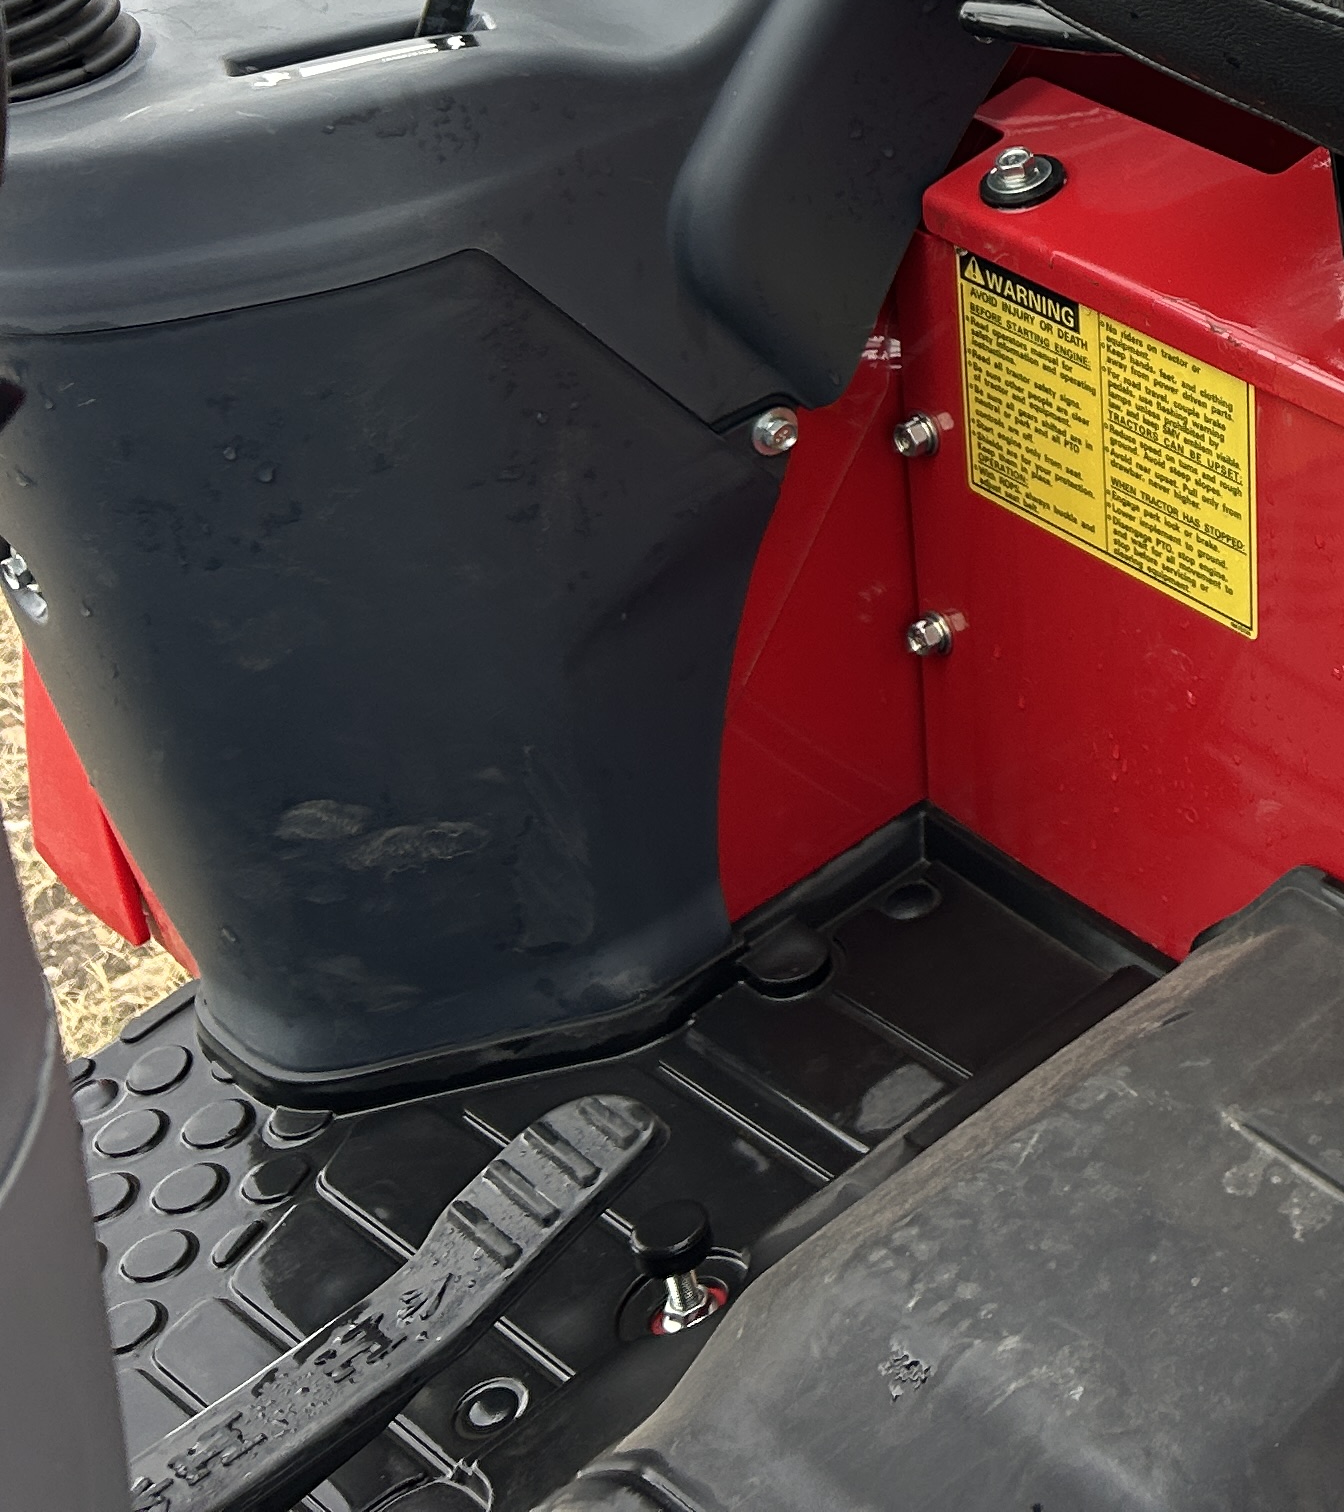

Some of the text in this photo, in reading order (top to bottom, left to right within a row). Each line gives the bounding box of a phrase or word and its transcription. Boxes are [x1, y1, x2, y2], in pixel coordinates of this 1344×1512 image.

[970, 287, 1088, 351] AVOID INJURY OR DEATH
[986, 271, 1074, 327] WARNING
[1106, 322, 1118, 336] No
[970, 302, 1089, 367] BEFORE STARTING ENGINE:
[973, 362, 983, 374] Be
[1108, 410, 1242, 484] TRACTORS CAN BE UPSET:
[1163, 425, 1181, 441] SMV
[1111, 477, 1245, 551] WHEN TRACTOR HAS STOPPED:
